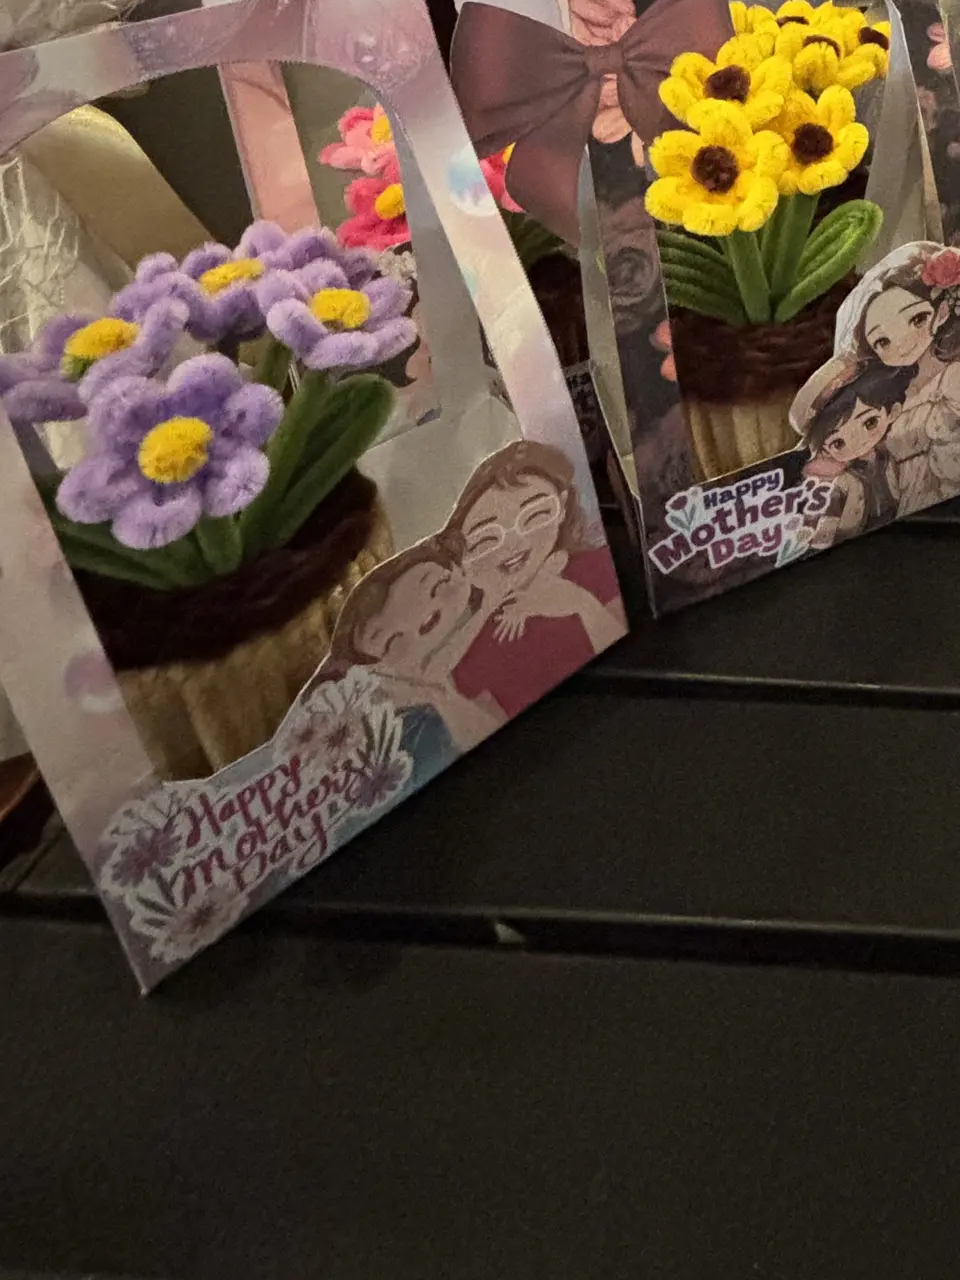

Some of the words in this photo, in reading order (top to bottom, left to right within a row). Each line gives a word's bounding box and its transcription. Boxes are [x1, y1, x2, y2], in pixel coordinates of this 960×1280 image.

[702, 471, 781, 510] Happy
[709, 522, 782, 565] Day
[180, 756, 303, 847] Happy
[232, 814, 329, 891] Day
